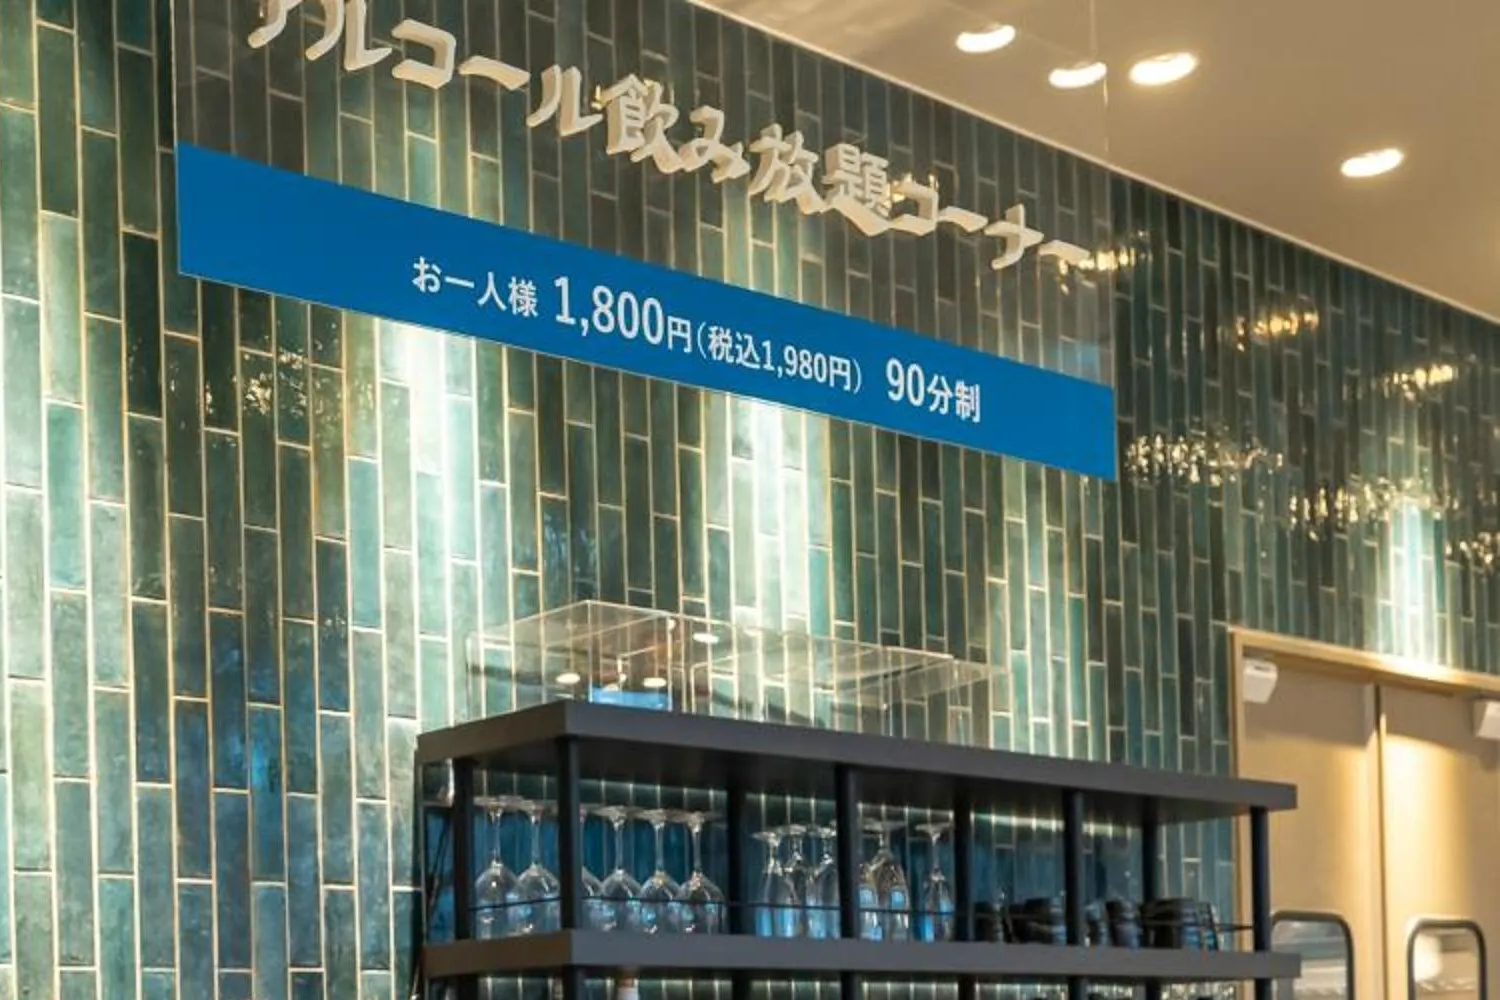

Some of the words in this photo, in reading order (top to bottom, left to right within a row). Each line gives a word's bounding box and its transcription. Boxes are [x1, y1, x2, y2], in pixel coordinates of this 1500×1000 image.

[411, 256, 539, 318] お一人様
[886, 357, 982, 423] 90分制
